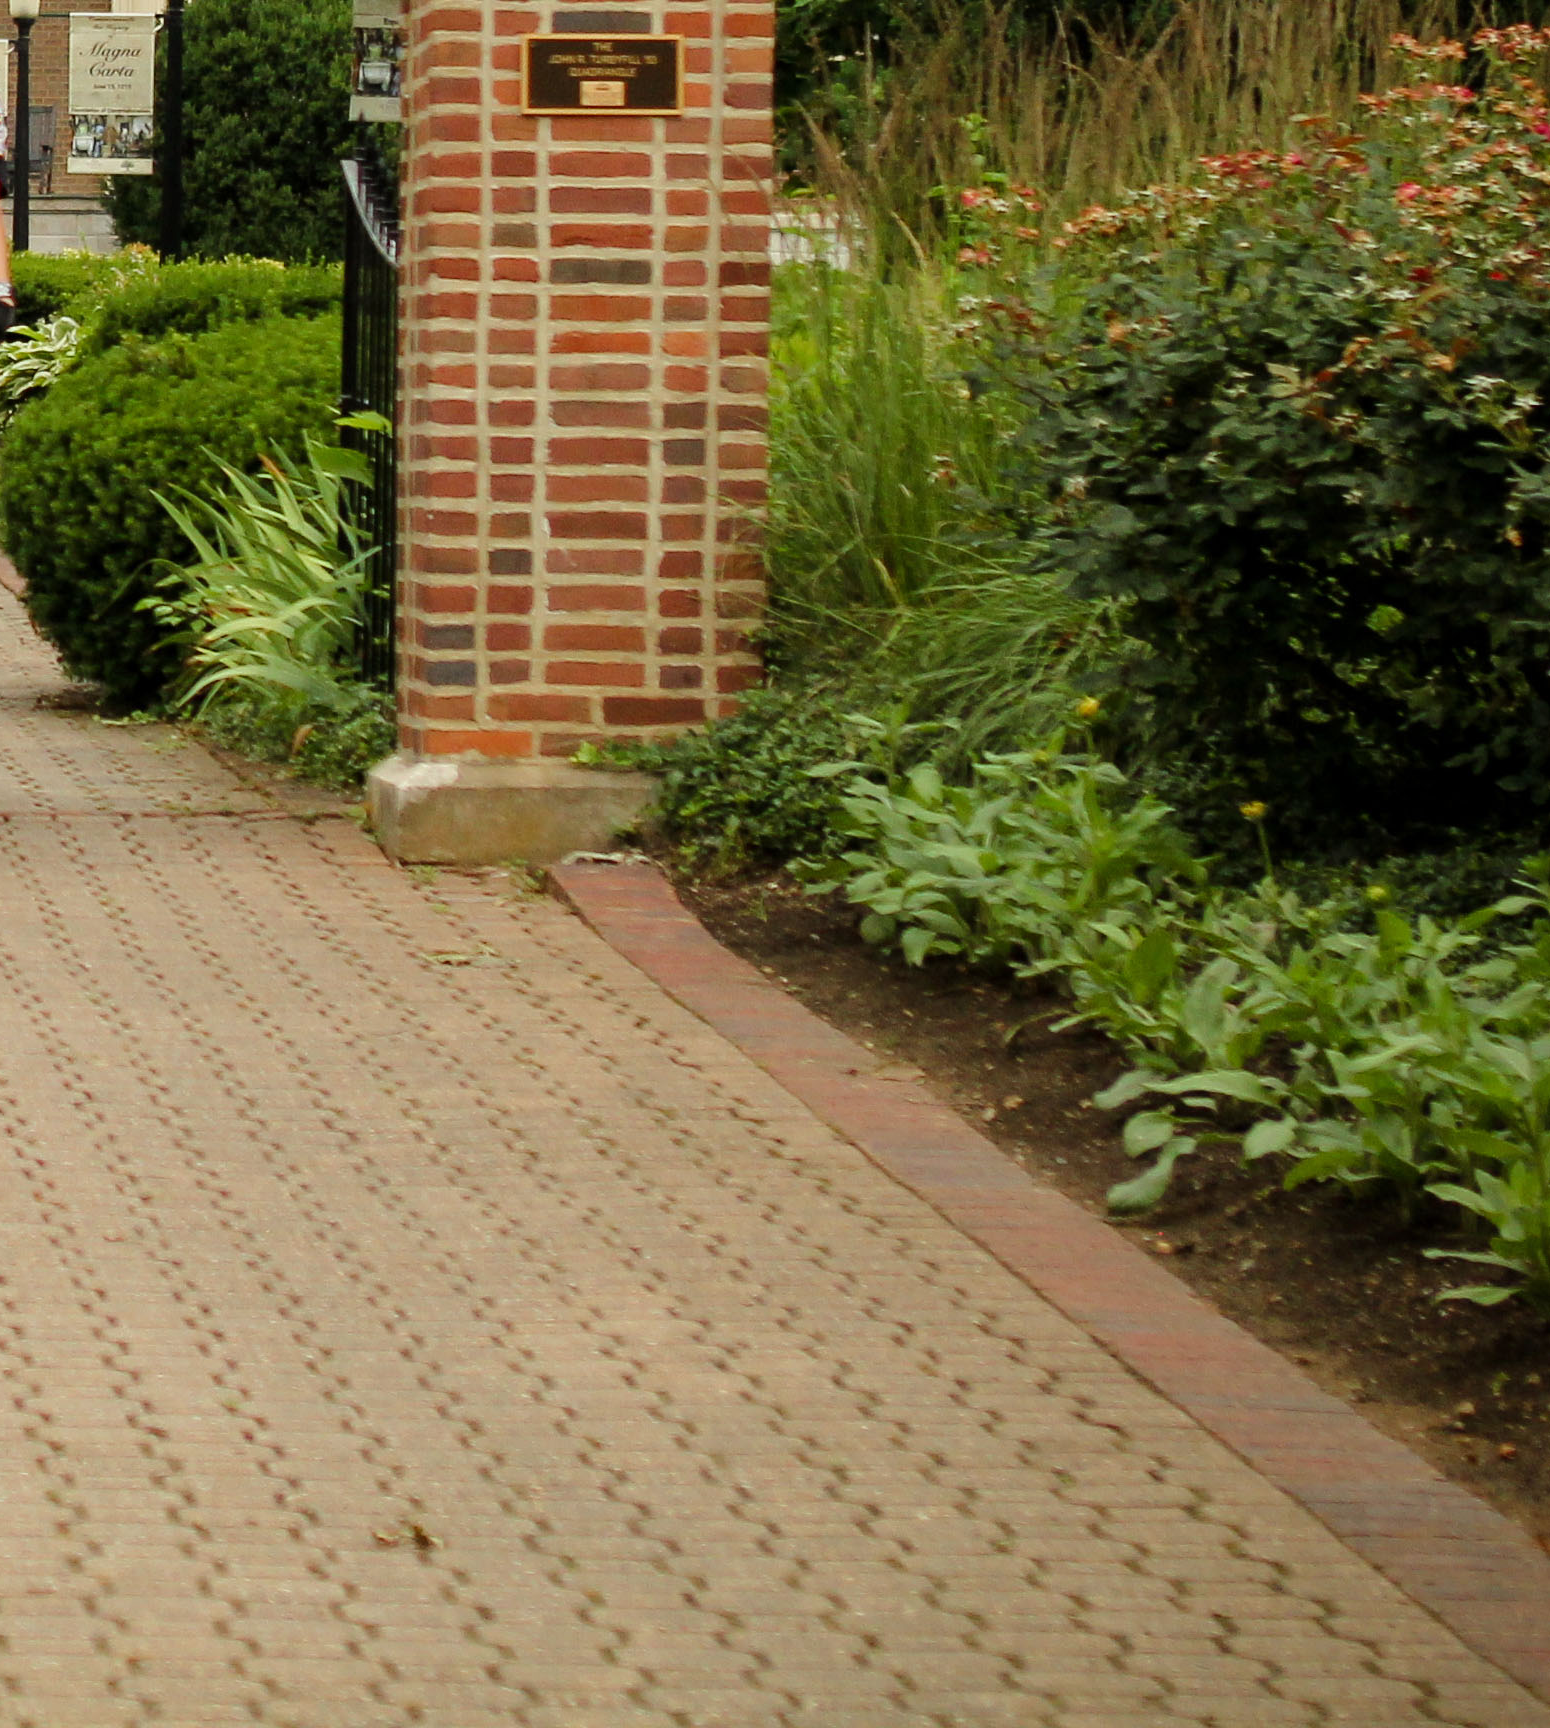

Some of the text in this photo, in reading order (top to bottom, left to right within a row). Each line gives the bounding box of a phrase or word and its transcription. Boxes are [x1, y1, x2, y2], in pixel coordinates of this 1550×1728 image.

[78, 41, 142, 62] Magna
[592, 41, 613, 52] THE
[88, 62, 136, 78] Carta
